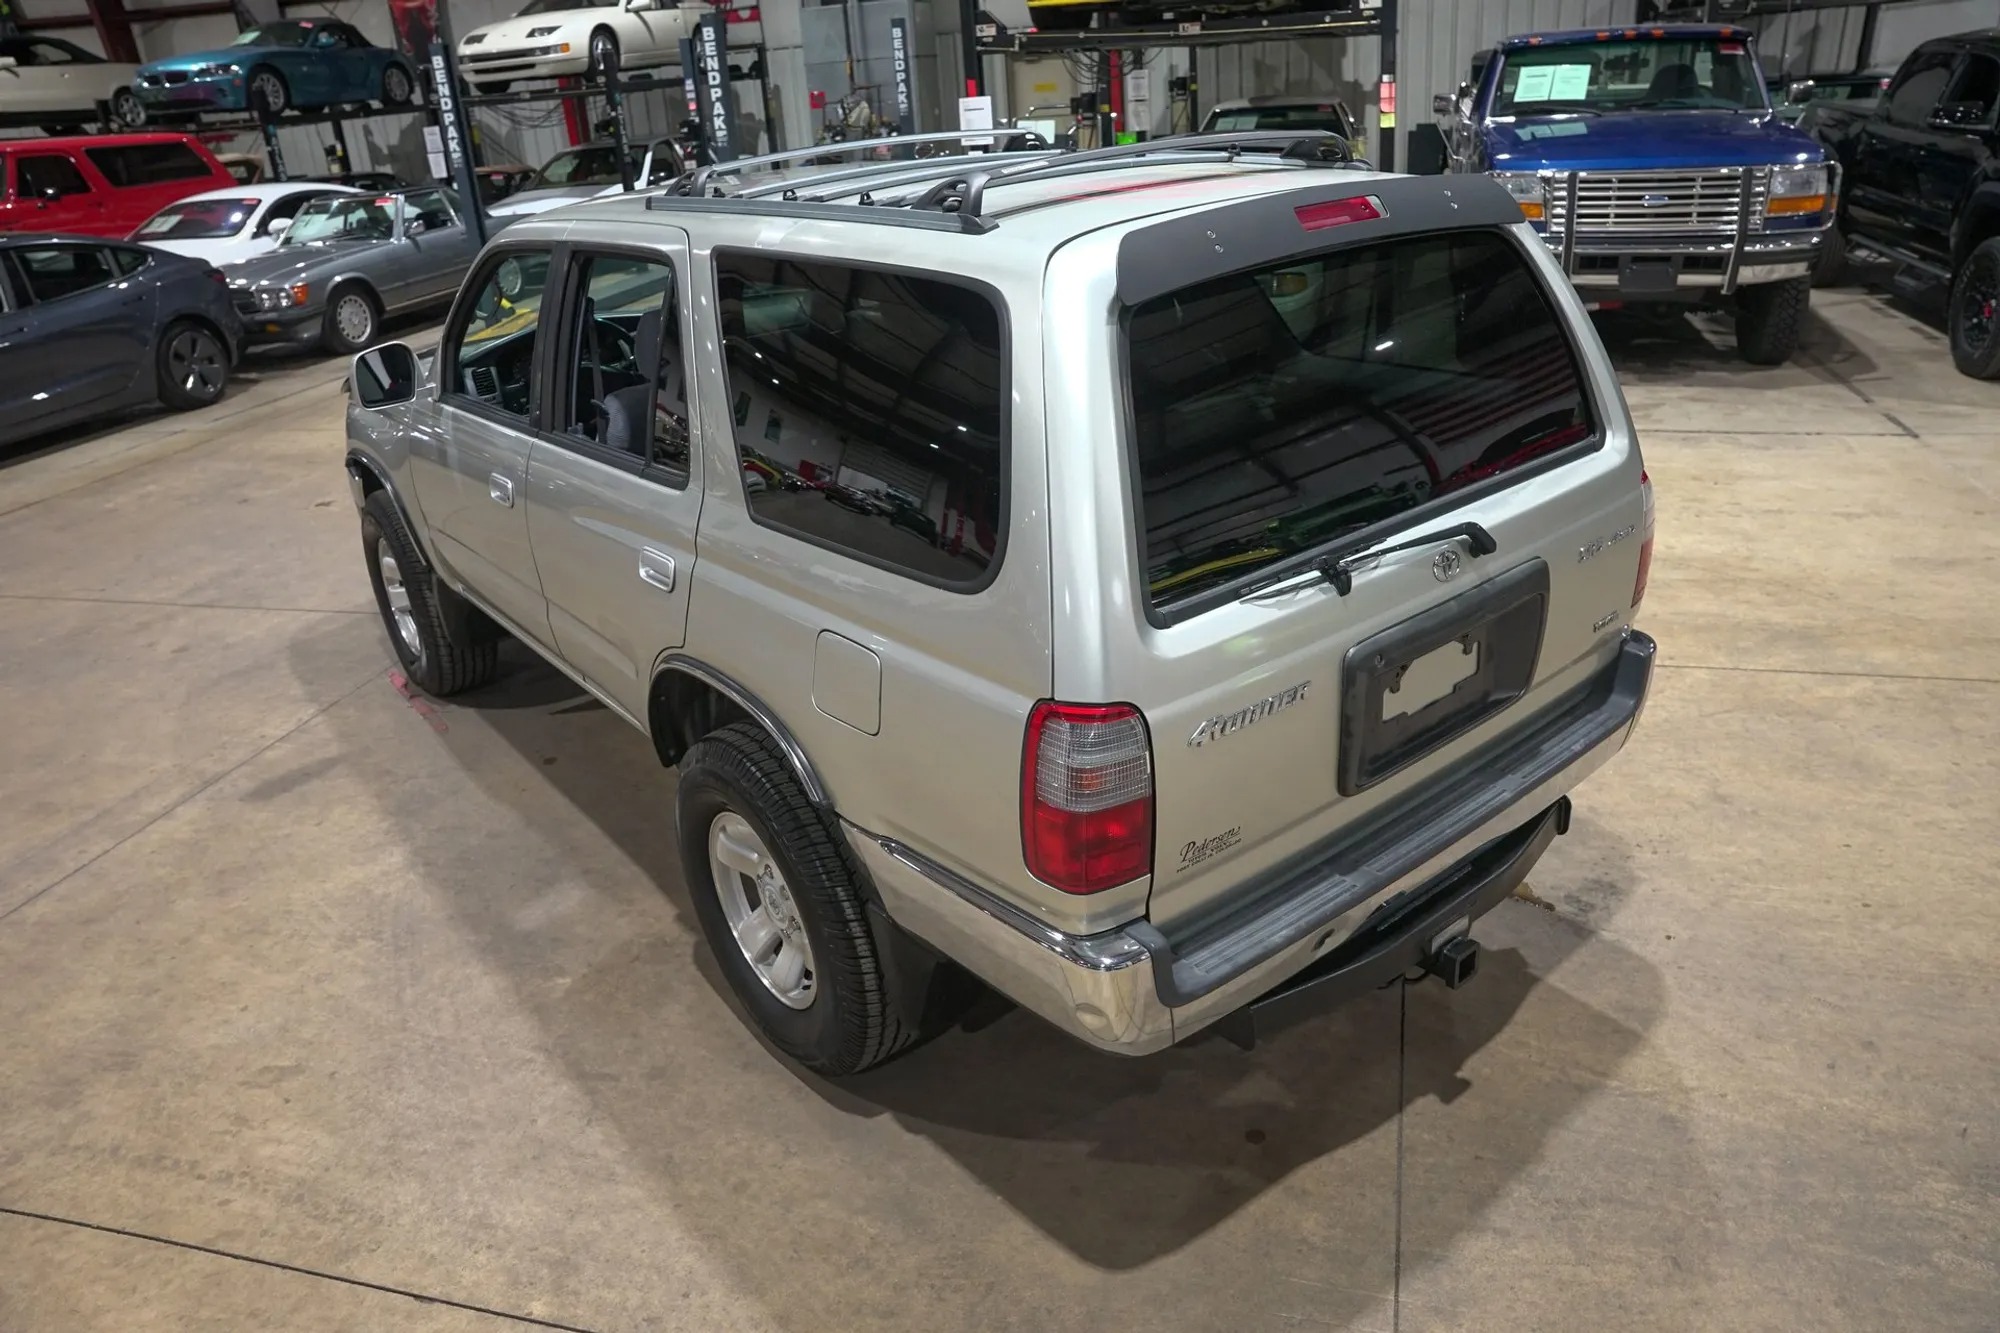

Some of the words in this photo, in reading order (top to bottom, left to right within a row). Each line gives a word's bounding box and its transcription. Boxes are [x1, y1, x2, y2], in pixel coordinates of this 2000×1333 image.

[431, 55, 462, 152] BENDPAK
[702, 26, 727, 130] BENDPAK
[892, 27, 908, 104] BENDPAK
